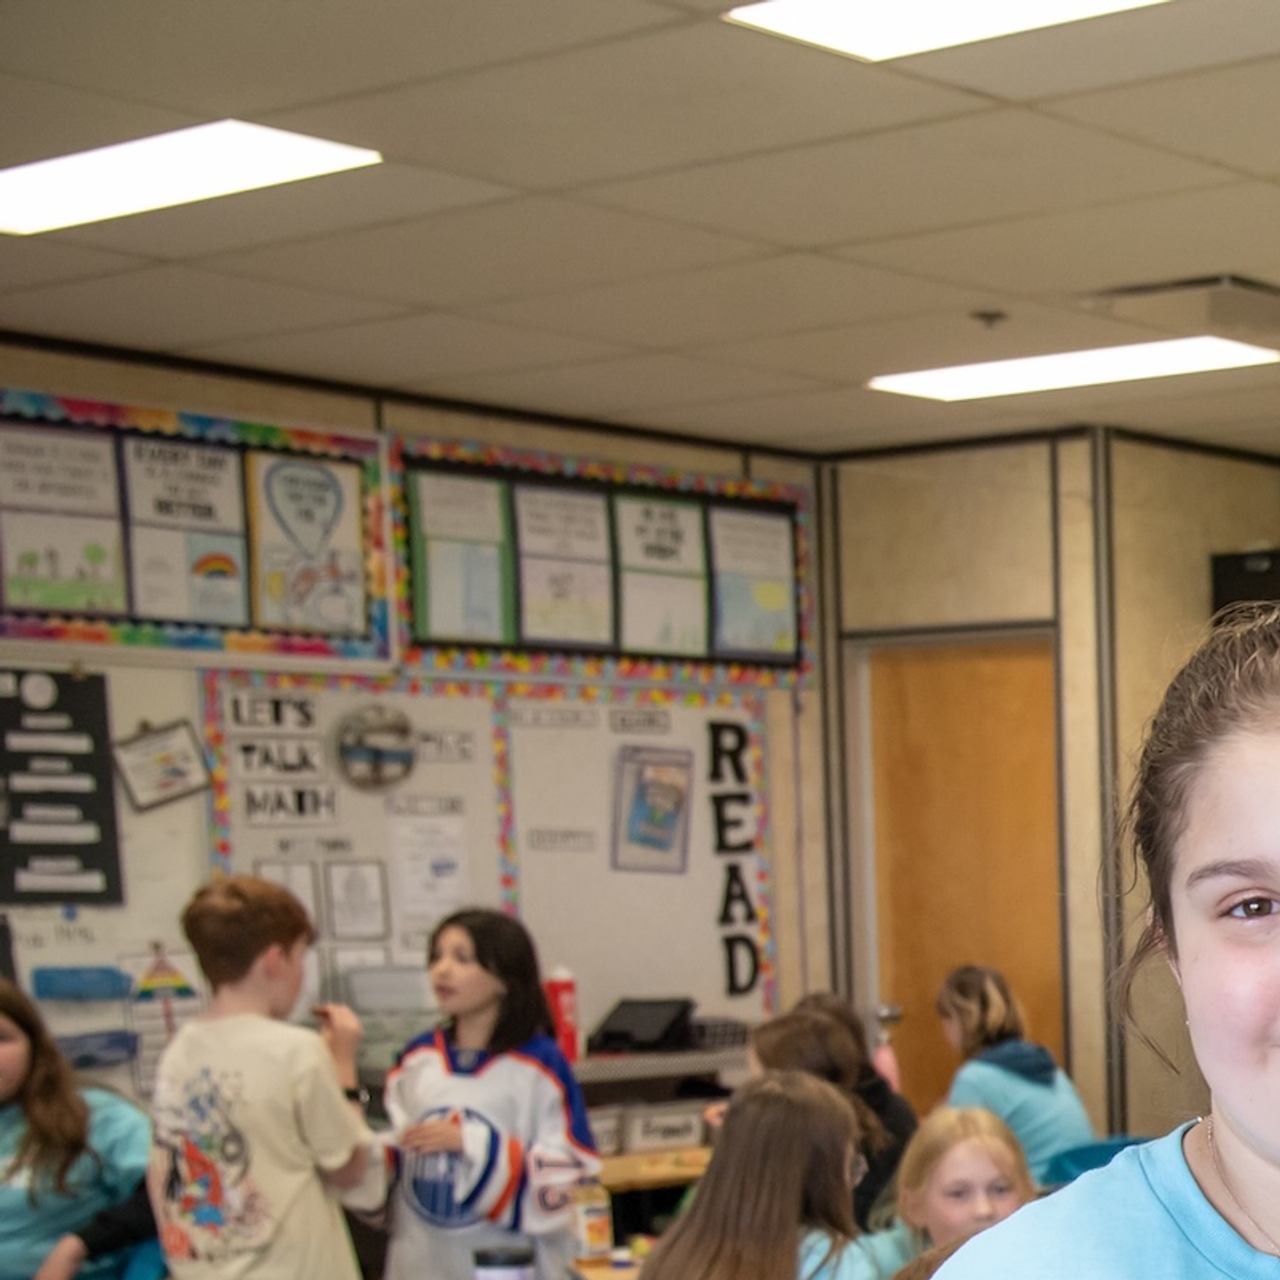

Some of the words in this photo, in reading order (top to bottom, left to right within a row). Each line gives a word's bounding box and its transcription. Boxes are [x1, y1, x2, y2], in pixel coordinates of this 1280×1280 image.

[232, 697, 317, 729] LET'S
[245, 786, 338, 818] MATH
[706, 720, 761, 997] READ
